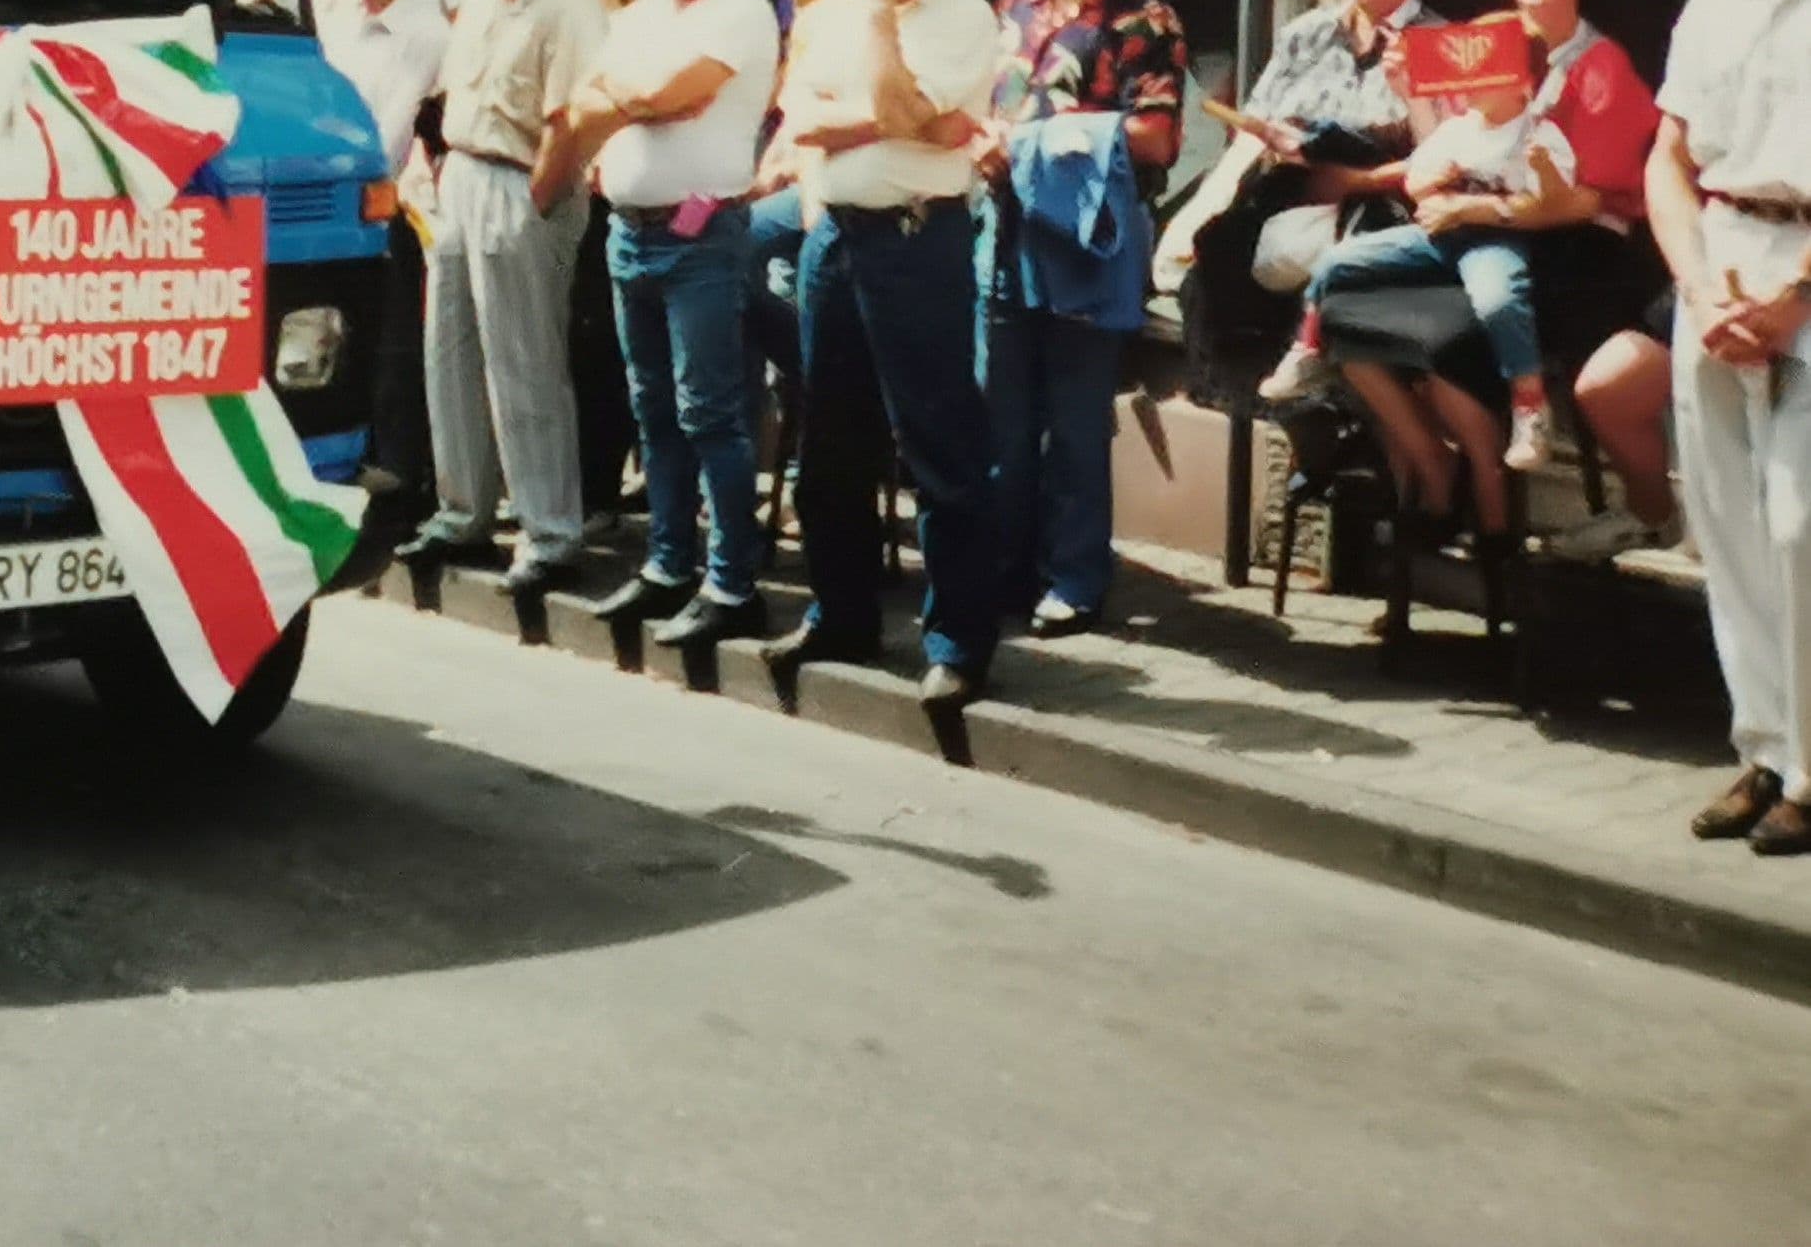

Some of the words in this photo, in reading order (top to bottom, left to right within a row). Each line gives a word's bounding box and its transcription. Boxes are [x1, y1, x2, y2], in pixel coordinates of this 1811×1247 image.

[9, 209, 78, 262] 140
[80, 207, 204, 260] JAHRE
[143, 328, 228, 383] 1847
